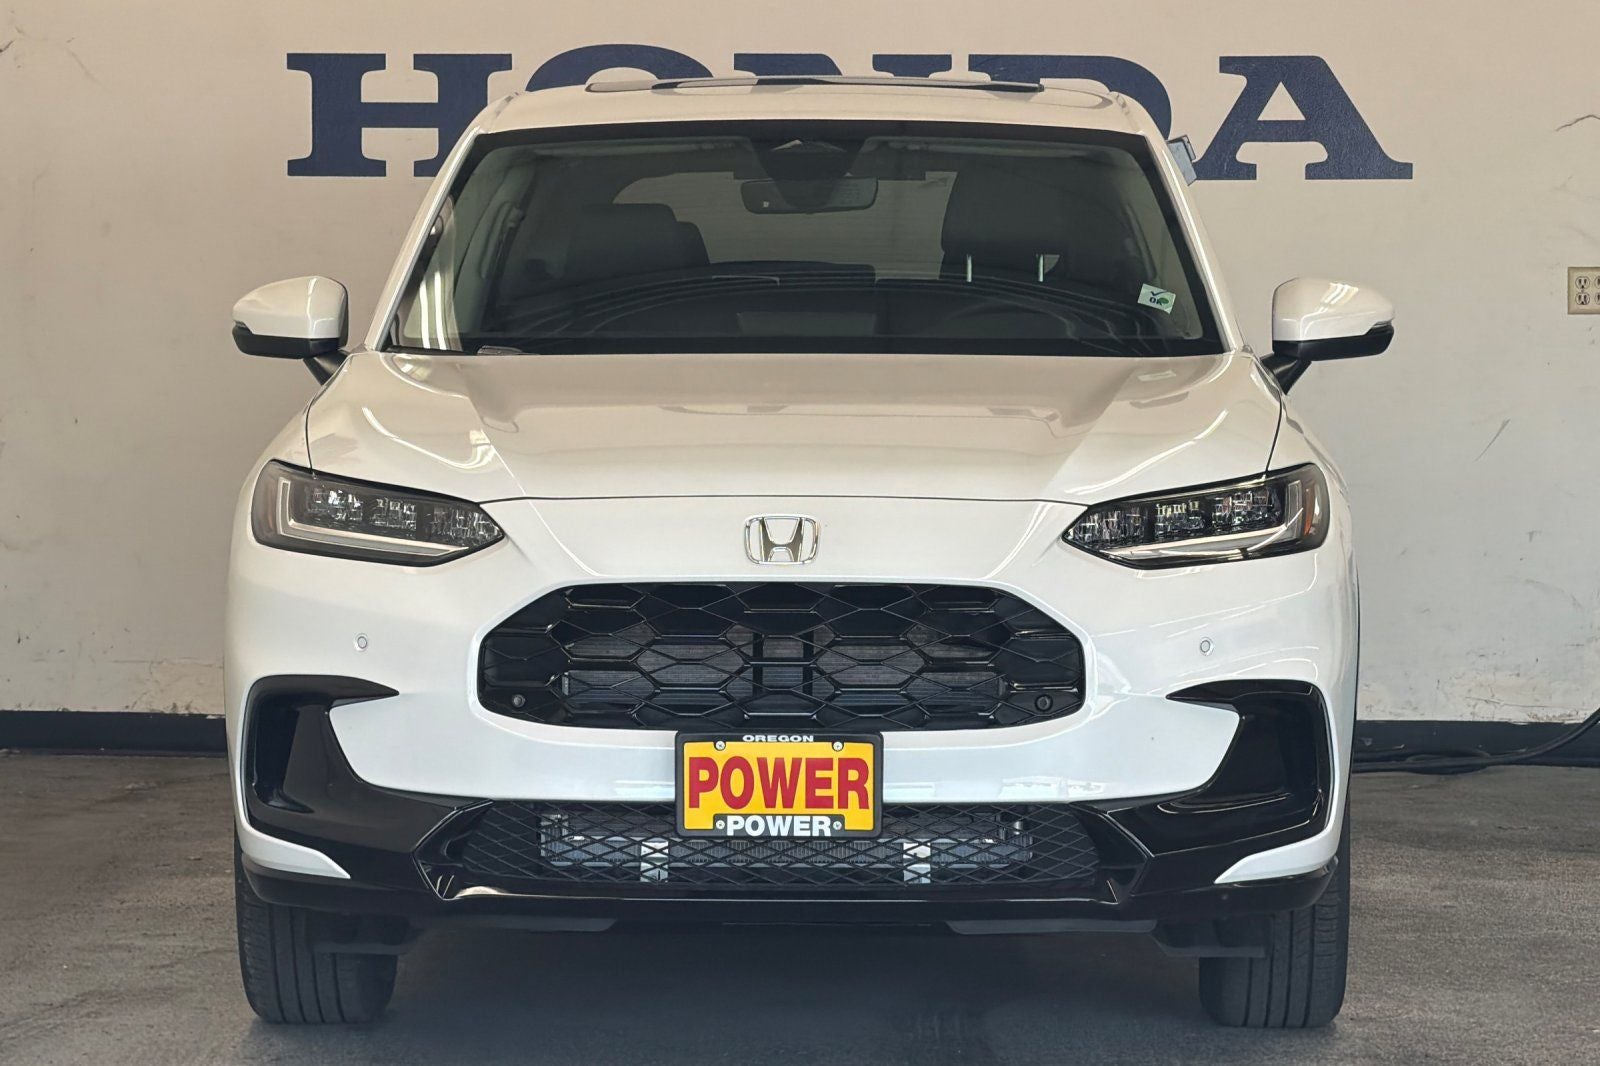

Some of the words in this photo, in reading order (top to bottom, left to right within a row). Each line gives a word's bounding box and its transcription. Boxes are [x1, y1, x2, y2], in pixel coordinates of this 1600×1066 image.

[287, 44, 1413, 180] HDA
[742, 734, 814, 742] OREGON
[688, 755, 870, 809] POWER
[726, 815, 832, 837] POWER
